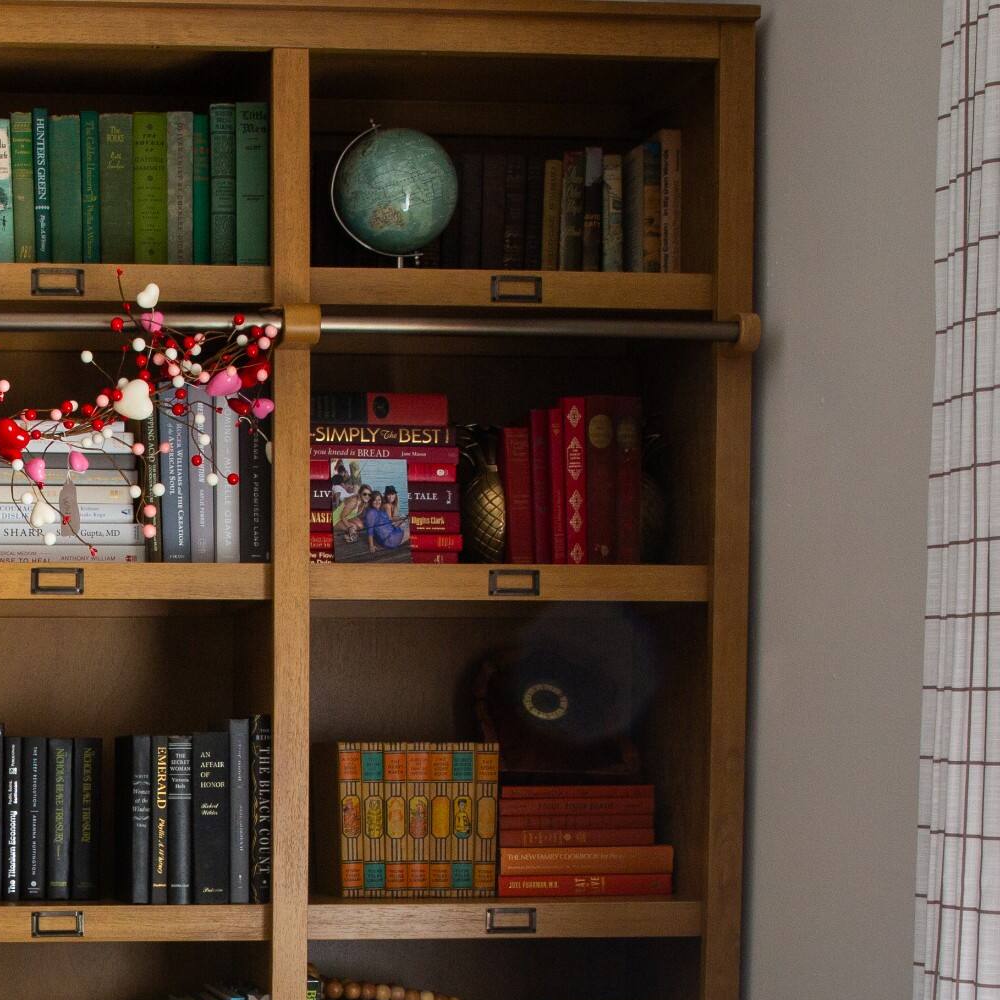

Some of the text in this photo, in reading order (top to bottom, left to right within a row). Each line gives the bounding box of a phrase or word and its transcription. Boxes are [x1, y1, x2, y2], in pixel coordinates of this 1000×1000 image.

[36, 118, 47, 200] HUNTER'S GREEN
[313, 448, 390, 458] you knead BREAD
[315, 427, 441, 443] SIMPLY The BEST
[414, 492, 438, 500] TALE
[2, 528, 43, 537] SHARP
[80, 528, 103, 539] Gupta,
[105, 528, 120, 537] MD
[177, 509, 185, 547] CREATION
[224, 511, 232, 547] OBAMA
[157, 746, 167, 809] EMERALD
[259, 747, 271, 875] THE BLACK COUNT
[8, 811, 18, 894] The Titanium Economy
